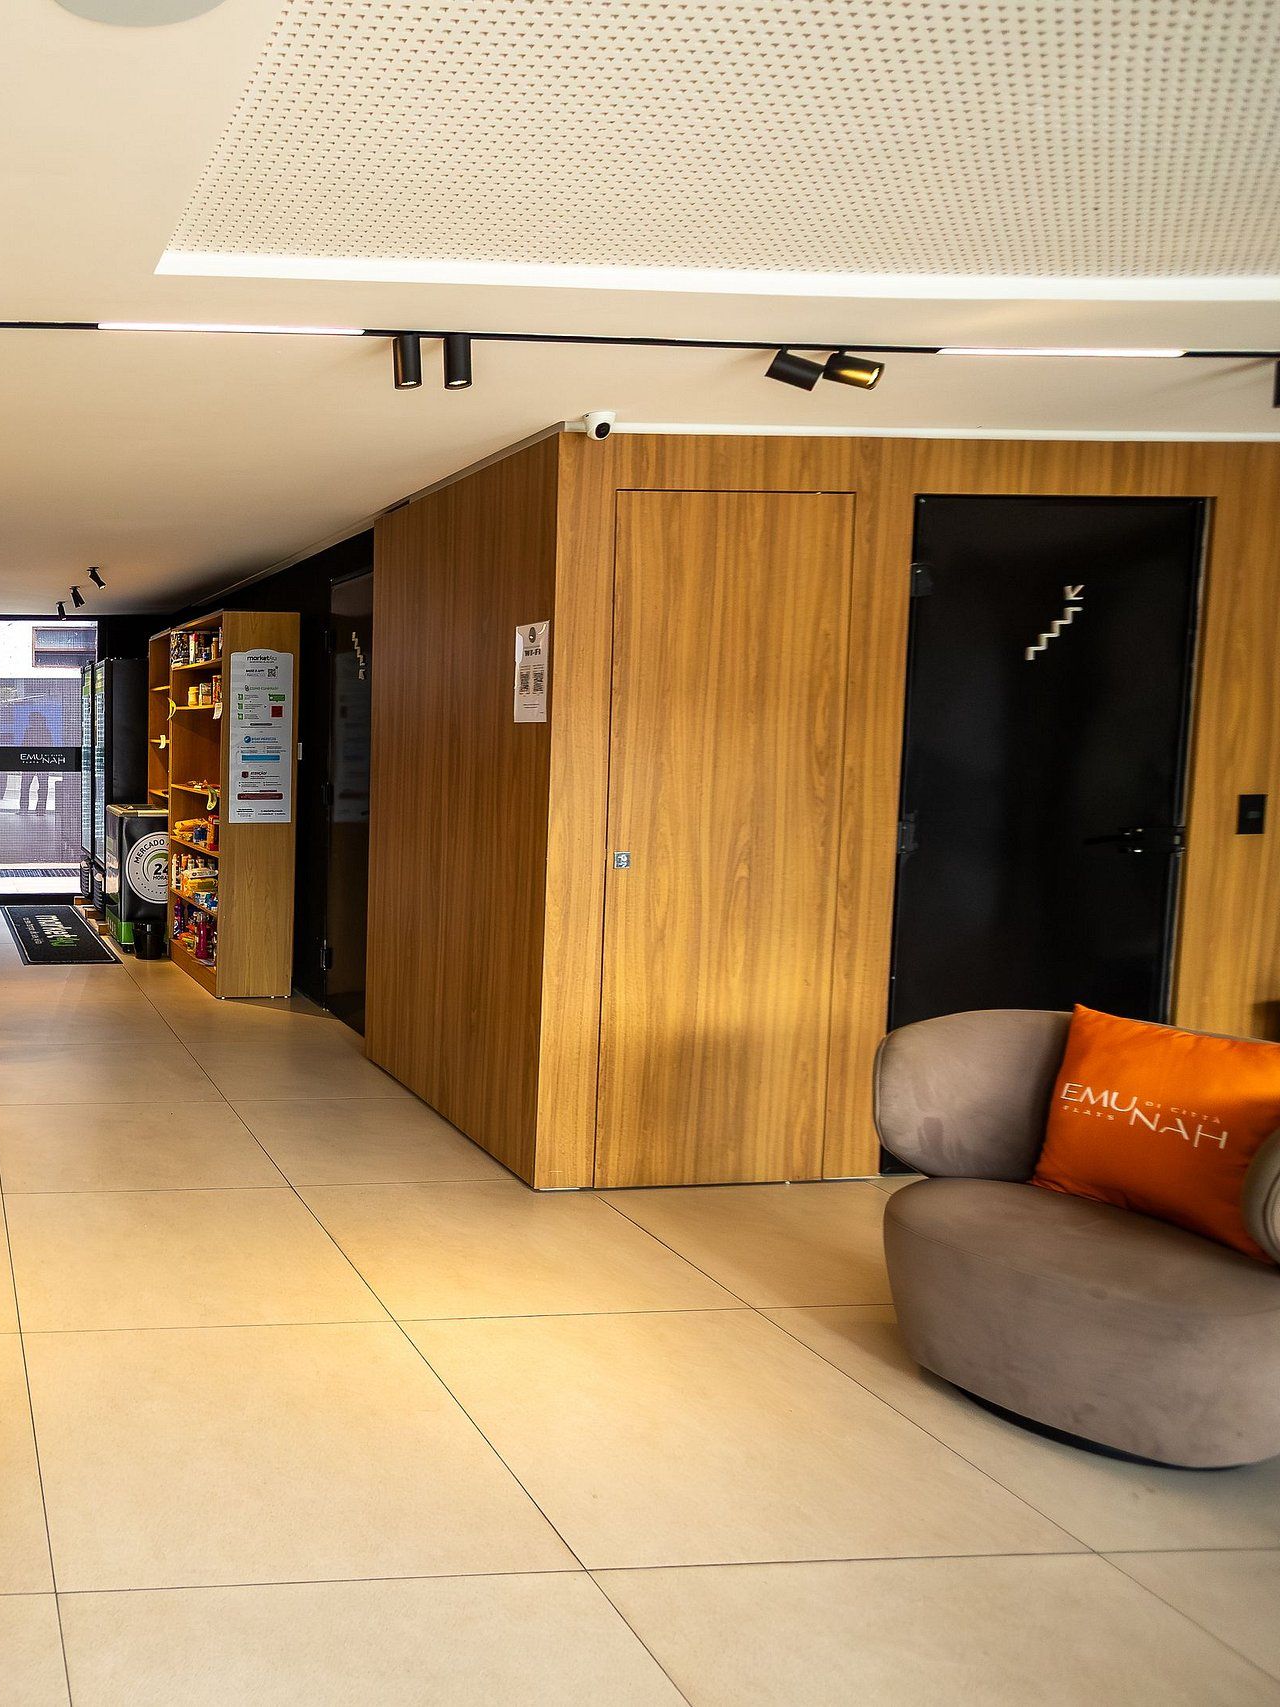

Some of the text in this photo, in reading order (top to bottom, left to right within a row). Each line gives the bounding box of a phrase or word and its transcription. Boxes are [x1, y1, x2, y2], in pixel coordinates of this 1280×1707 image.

[20, 753, 66, 765] EMUNAH
[133, 838, 165, 864] MERCADO
[1060, 1082, 1228, 1149] EMUNAH
[1062, 1105, 1115, 1121] FLATS
